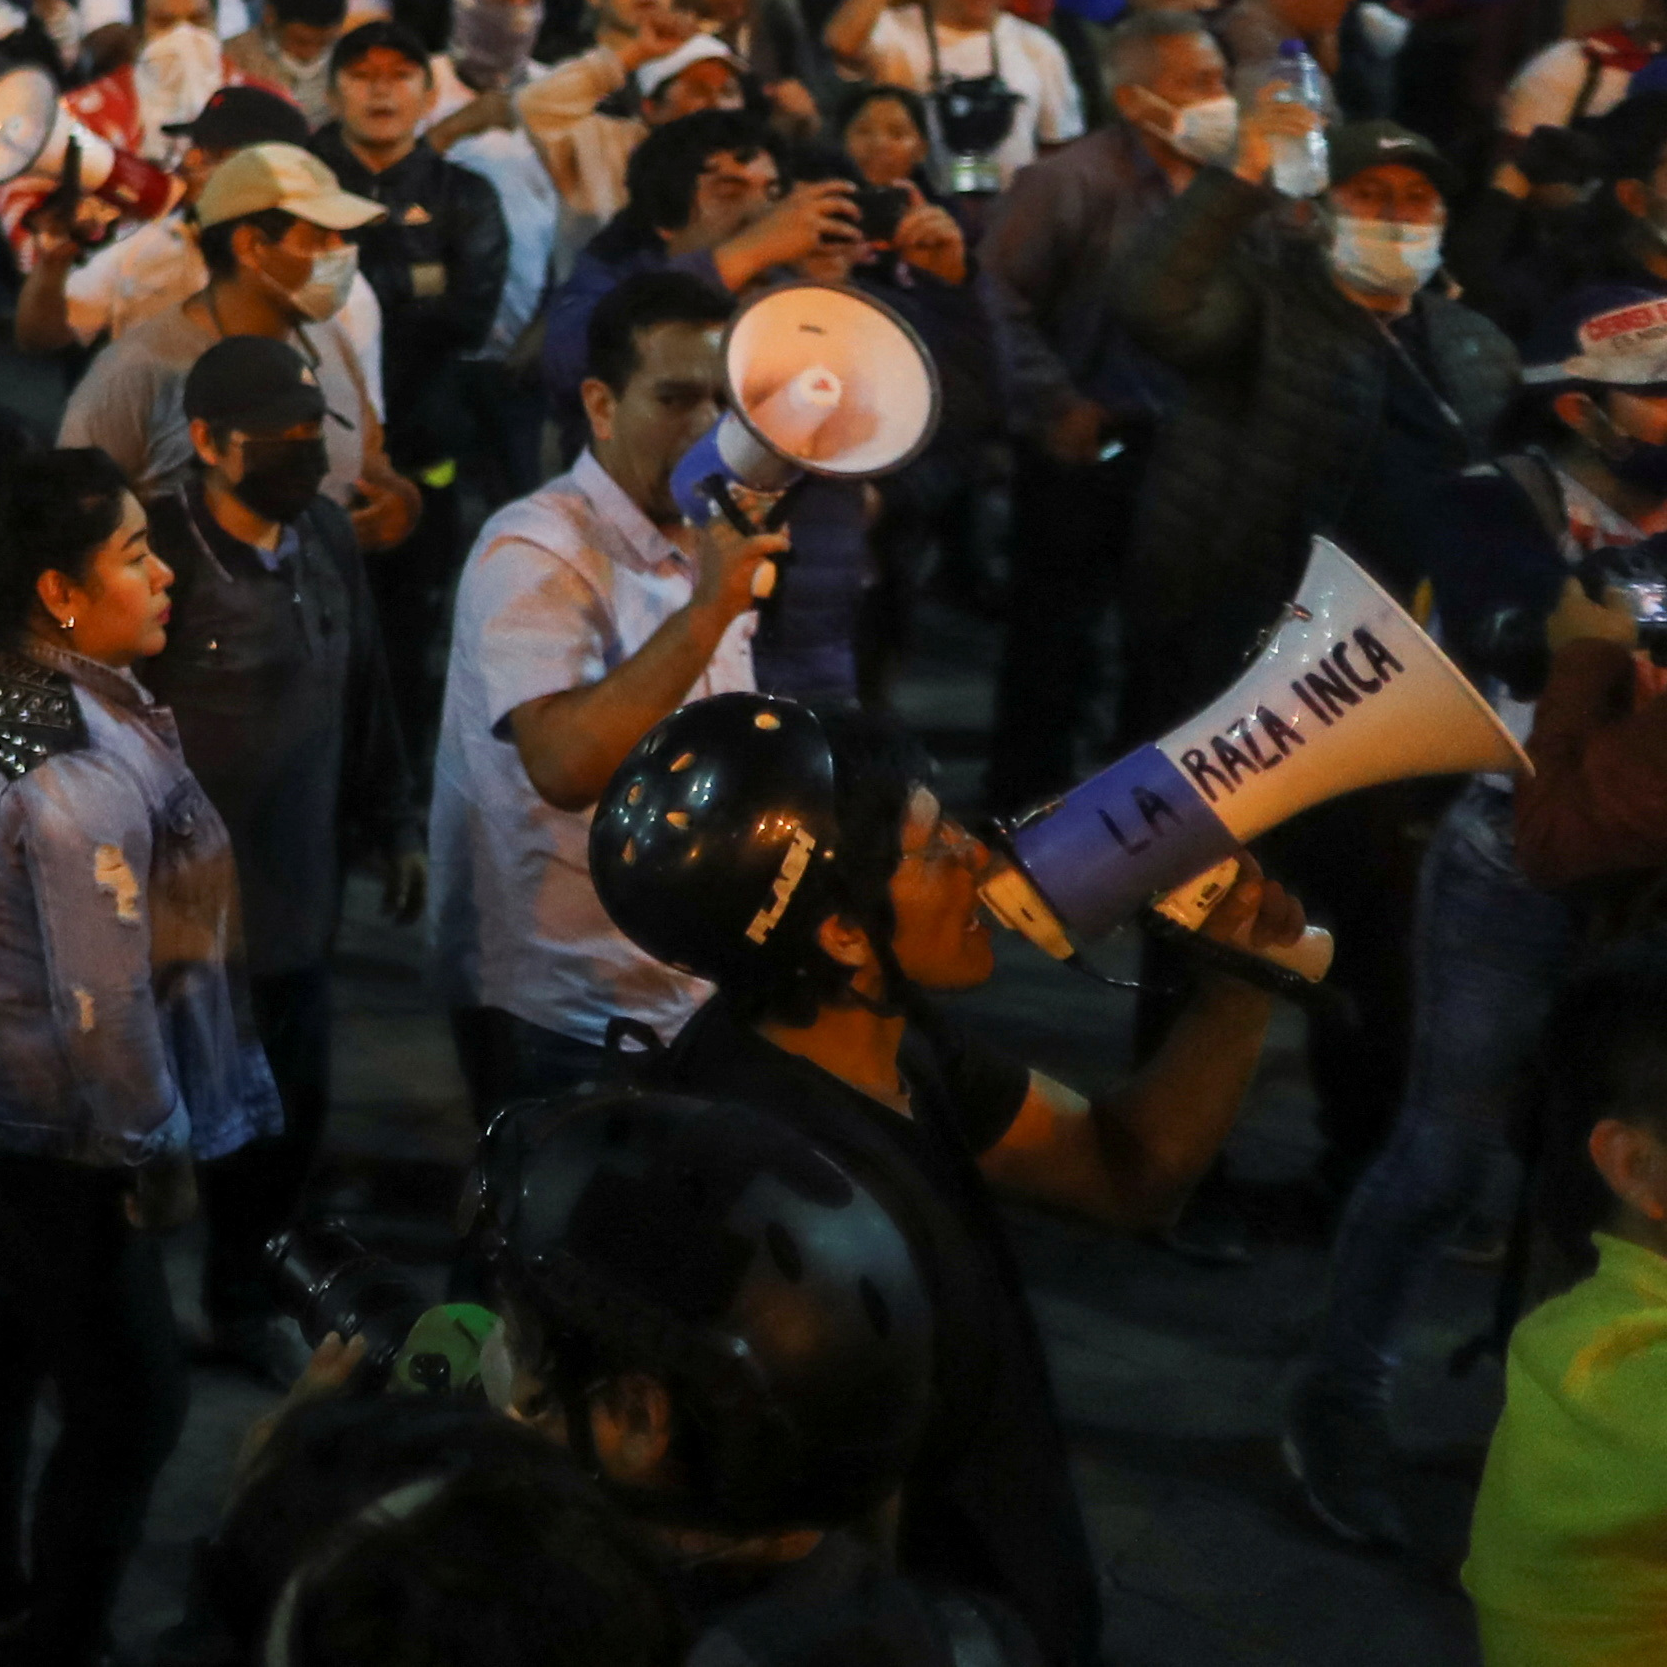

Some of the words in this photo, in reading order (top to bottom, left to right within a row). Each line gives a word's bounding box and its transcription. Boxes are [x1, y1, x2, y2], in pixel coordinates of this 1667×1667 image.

[1097, 786, 1184, 856] LA
[1180, 705, 1306, 804] RAZA
[1291, 626, 1405, 727] INCA
